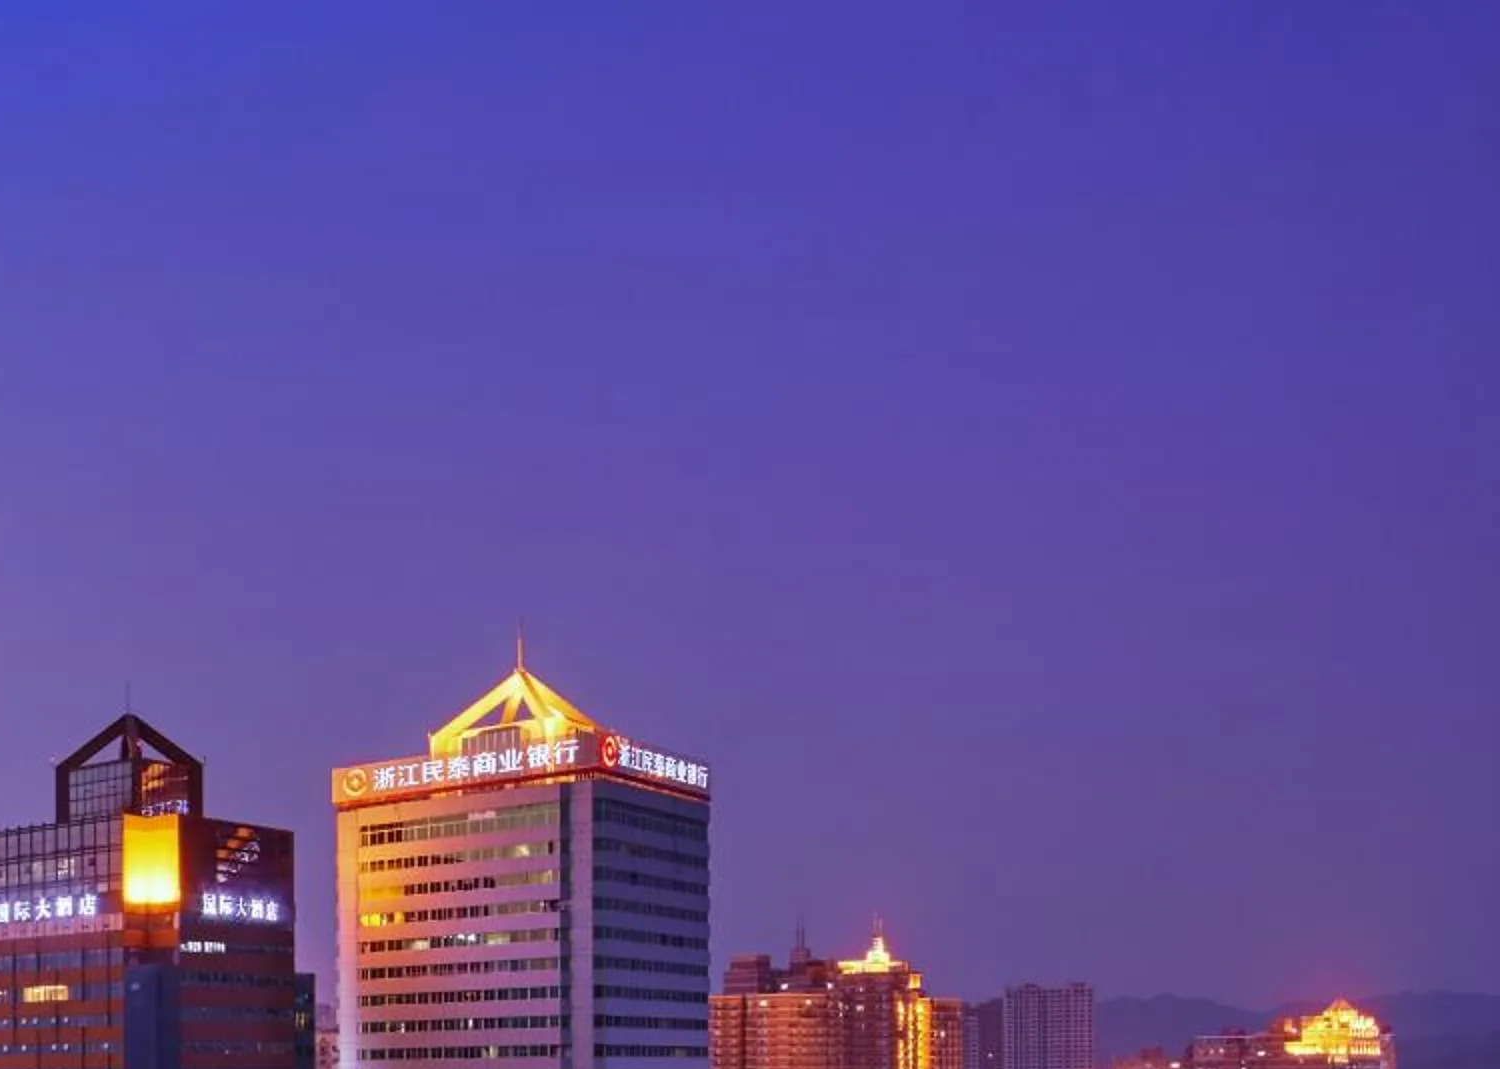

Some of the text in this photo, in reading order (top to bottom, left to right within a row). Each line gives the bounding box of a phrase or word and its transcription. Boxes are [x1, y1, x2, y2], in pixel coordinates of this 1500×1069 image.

[373, 739, 580, 792] 浙江民泰商业银行
[203, 892, 279, 921] 国际大酒店
